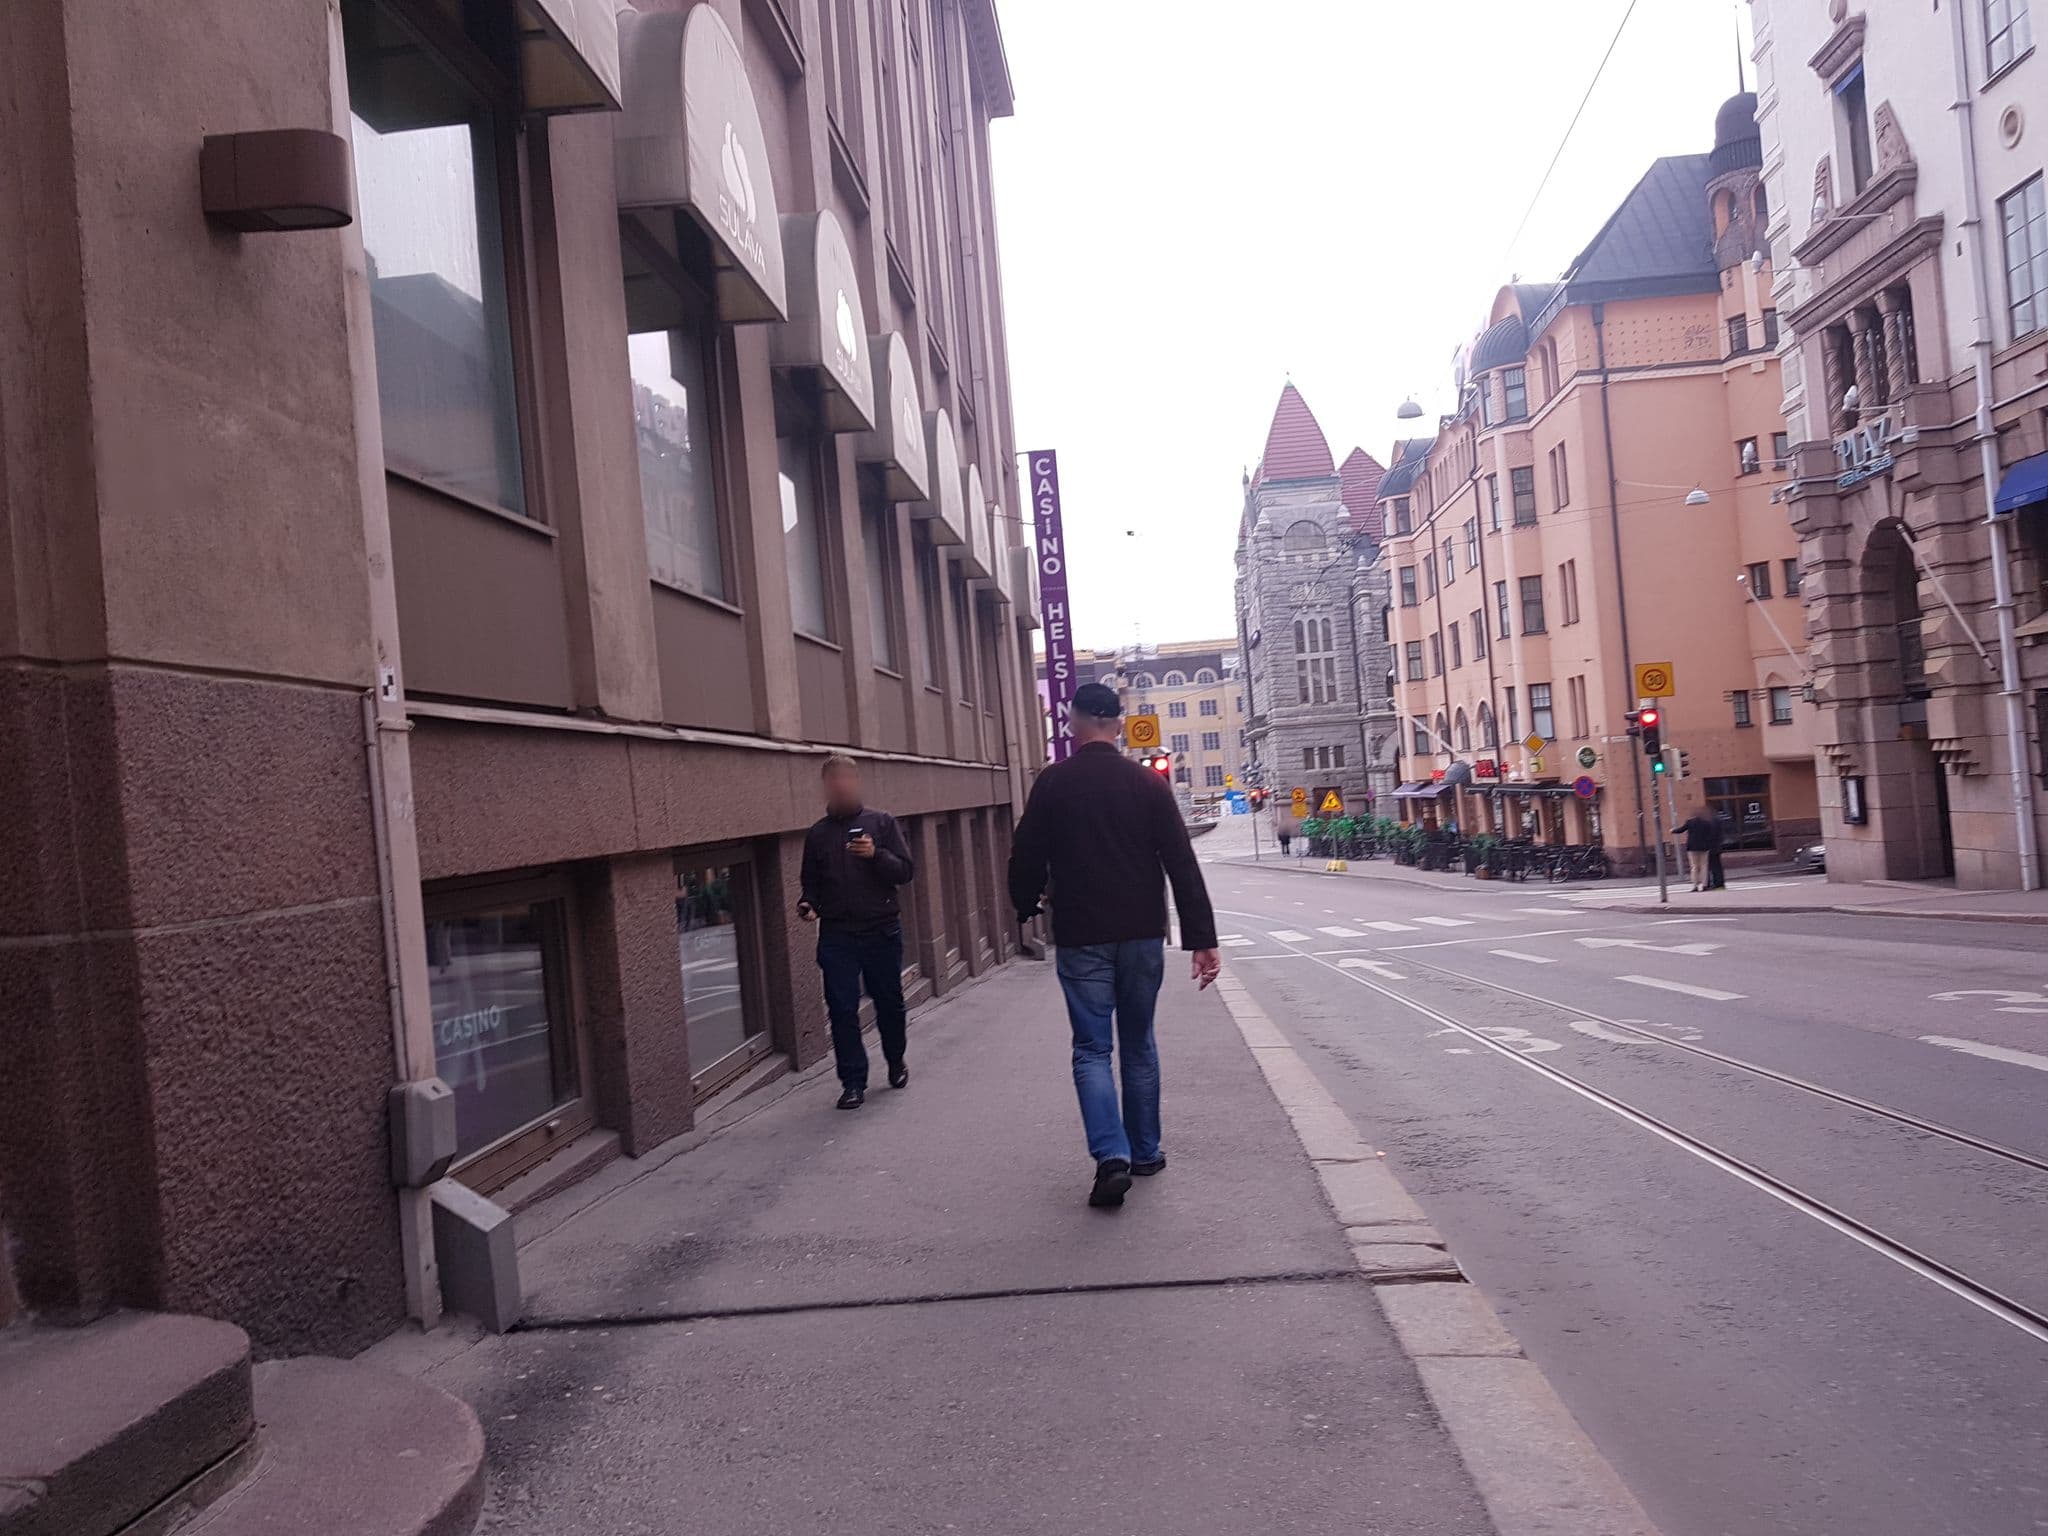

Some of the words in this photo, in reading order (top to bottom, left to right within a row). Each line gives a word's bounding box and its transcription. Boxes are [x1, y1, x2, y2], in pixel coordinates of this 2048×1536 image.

[719, 194, 766, 275] SULAVA
[1035, 458, 1061, 575] CASINO
[1048, 602, 1075, 758] HELSINKI
[1647, 673, 1664, 686] 30
[1135, 725, 1151, 737] 30
[440, 1005, 500, 1046] CASINO
